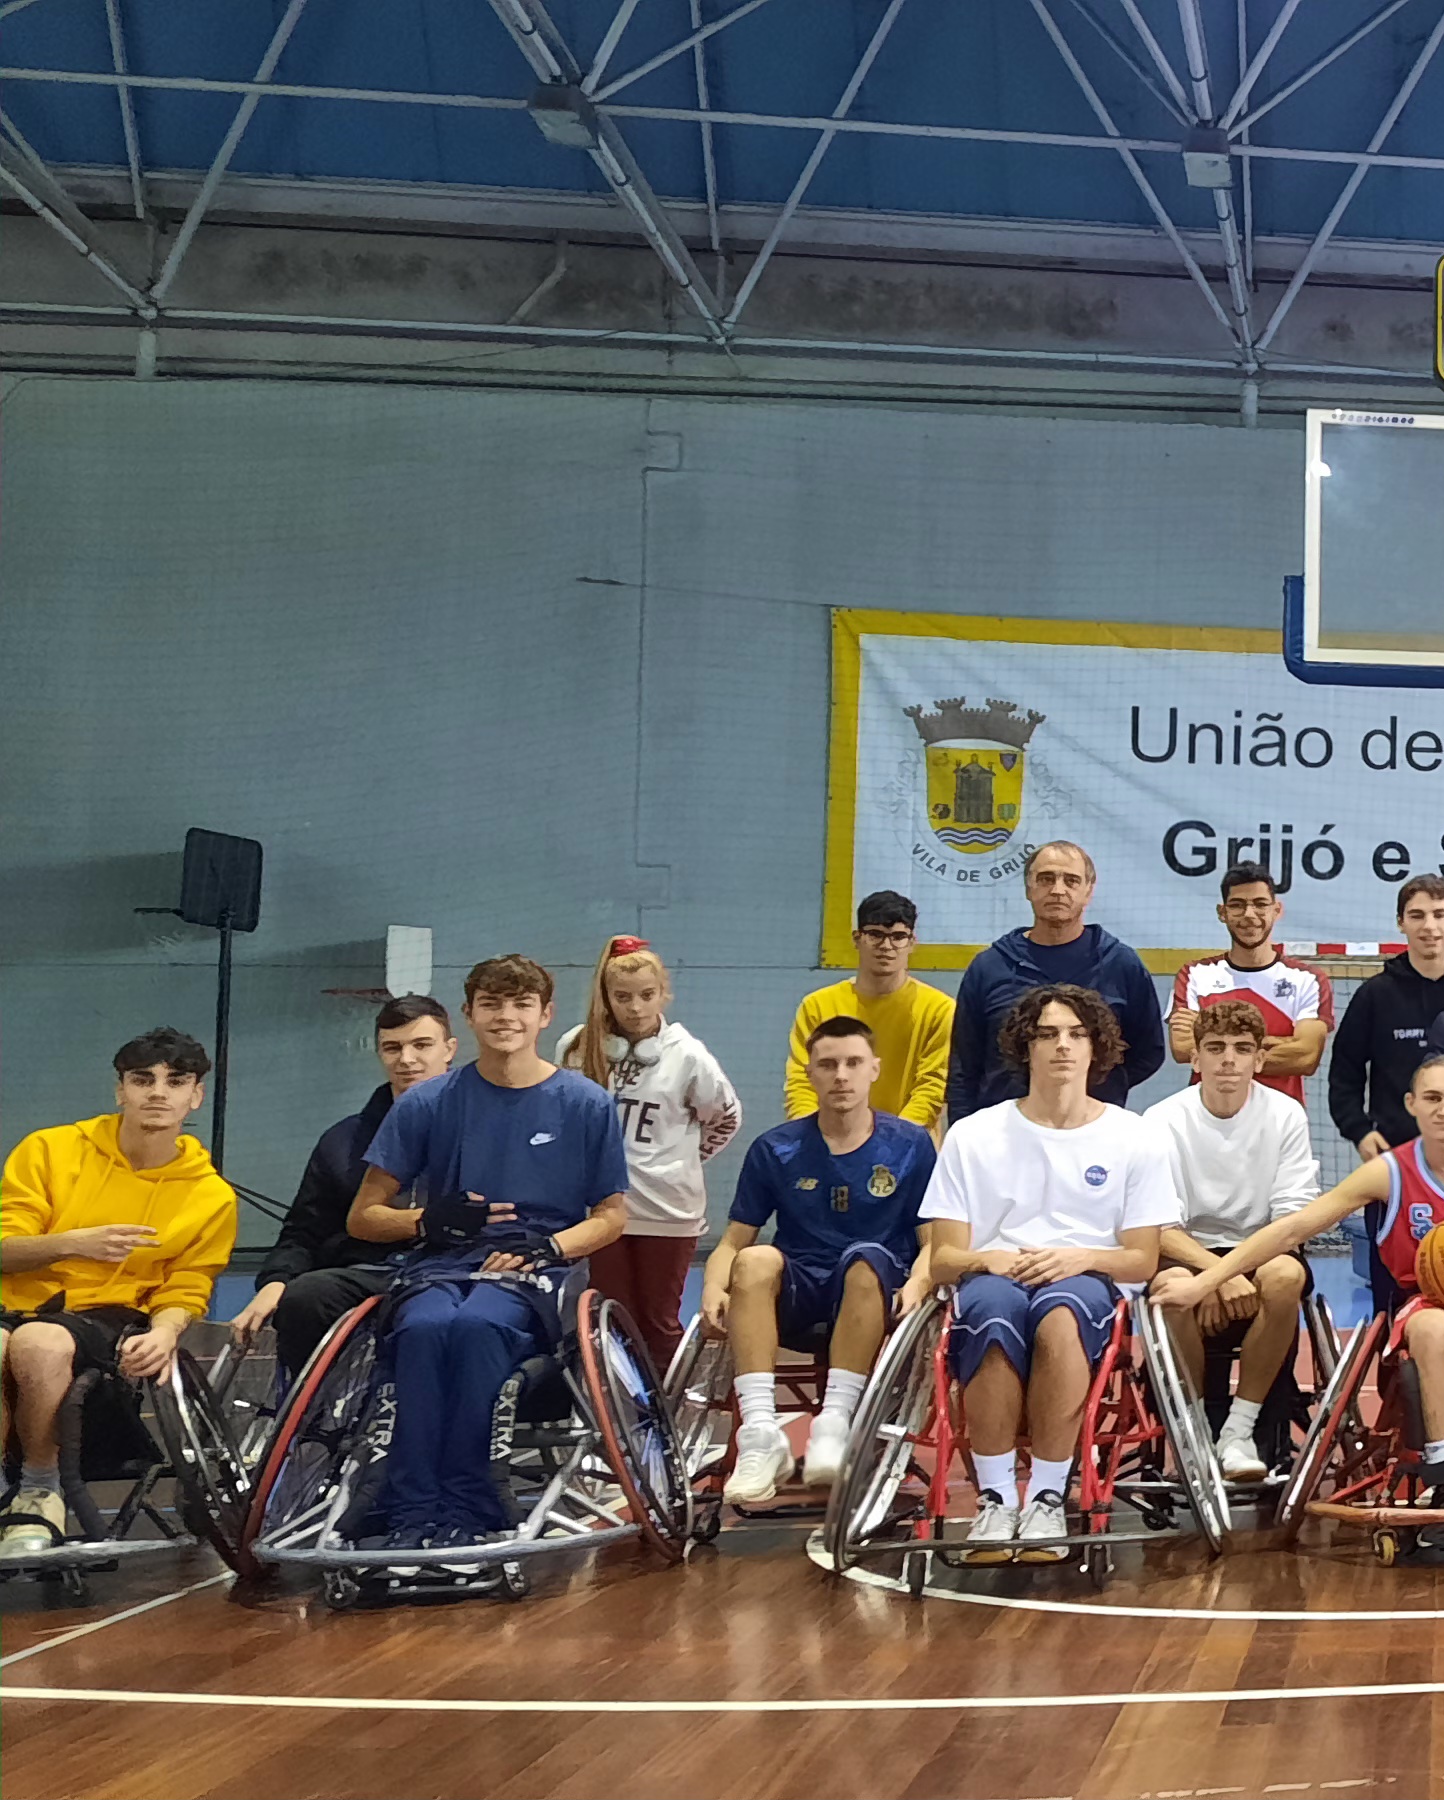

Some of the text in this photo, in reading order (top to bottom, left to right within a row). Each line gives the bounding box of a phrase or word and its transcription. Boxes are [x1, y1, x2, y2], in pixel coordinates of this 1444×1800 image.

[1131, 705, 1334, 769] União
[1360, 715, 1444, 772] de
[912, 843, 947, 876] VILA
[956, 869, 981, 882] DE
[1162, 819, 1345, 895] Grijó
[1372, 840, 1411, 882] e
[619, 1098, 661, 1144] TE
[369, 1382, 398, 1464] EXTRA
[496, 1379, 520, 1459] EXTRA
